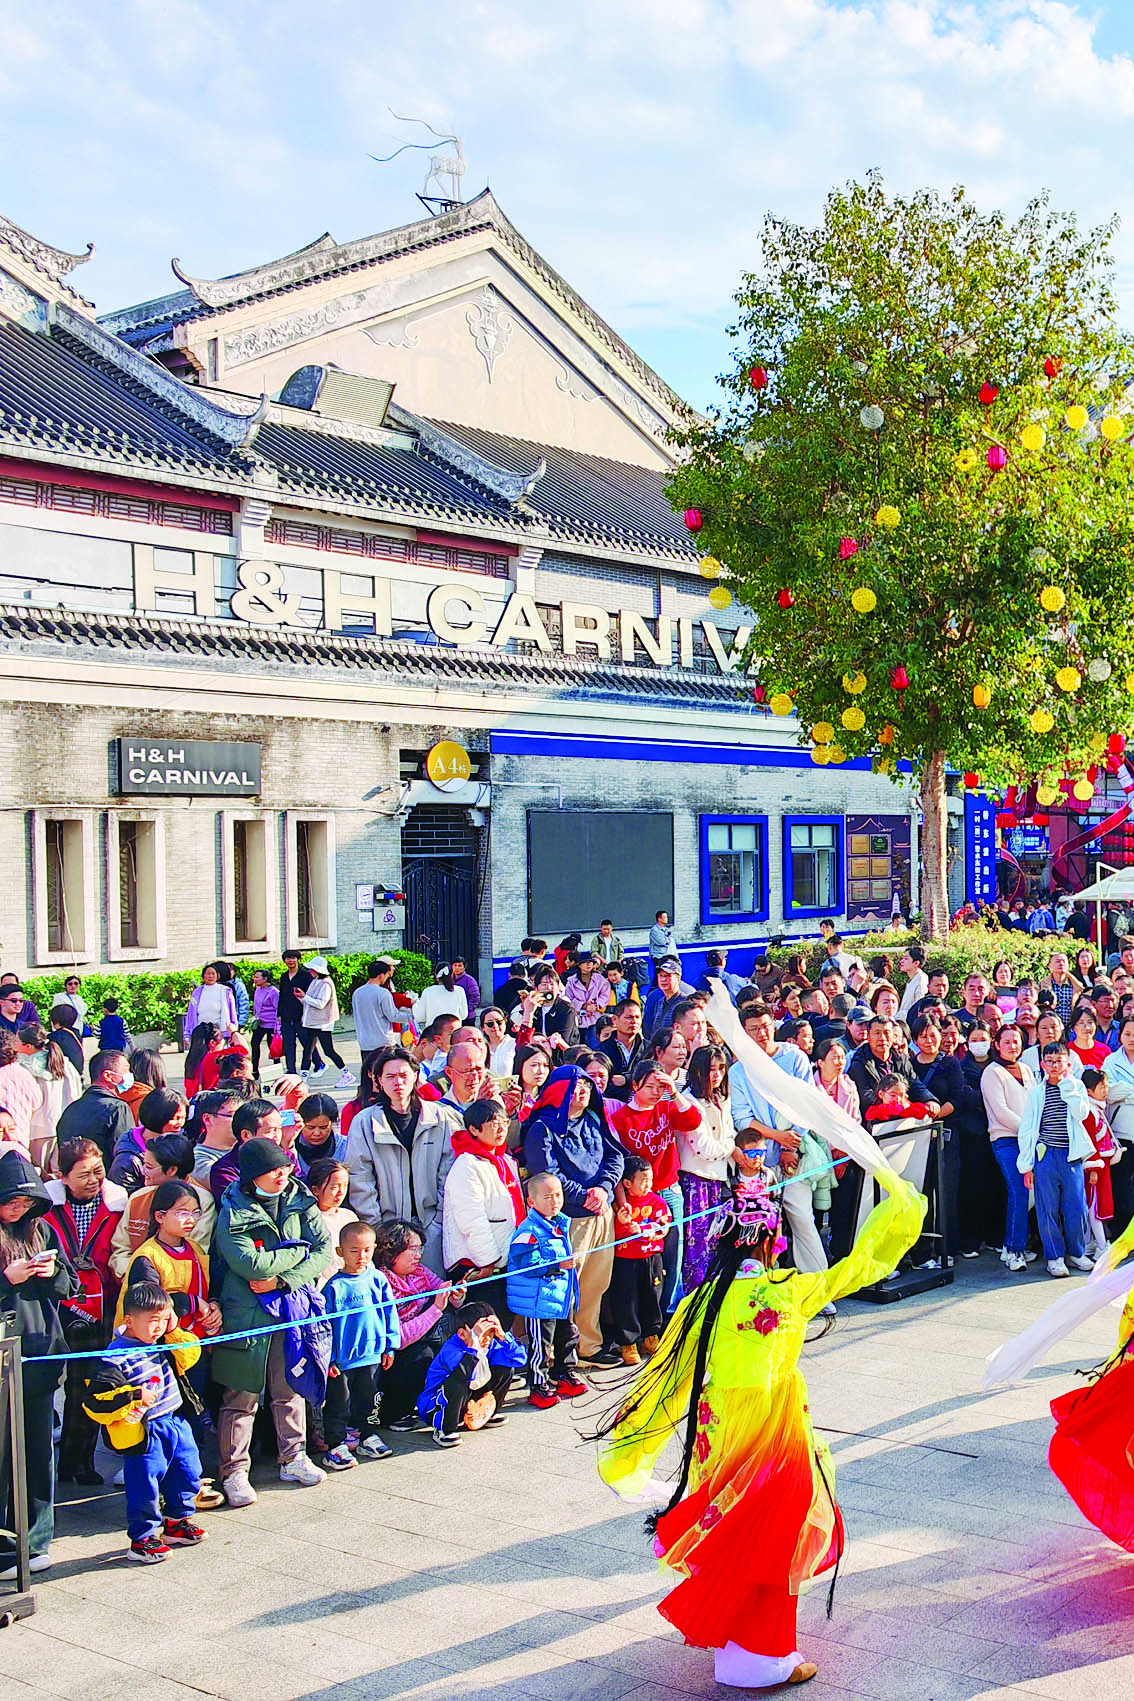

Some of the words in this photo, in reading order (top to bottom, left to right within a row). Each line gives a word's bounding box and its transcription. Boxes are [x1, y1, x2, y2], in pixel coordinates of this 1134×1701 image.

[131, 543, 393, 637] H&H
[427, 583, 760, 676] CARNIV
[128, 747, 186, 764] H&H
[128, 768, 256, 786] CARNIVAL
